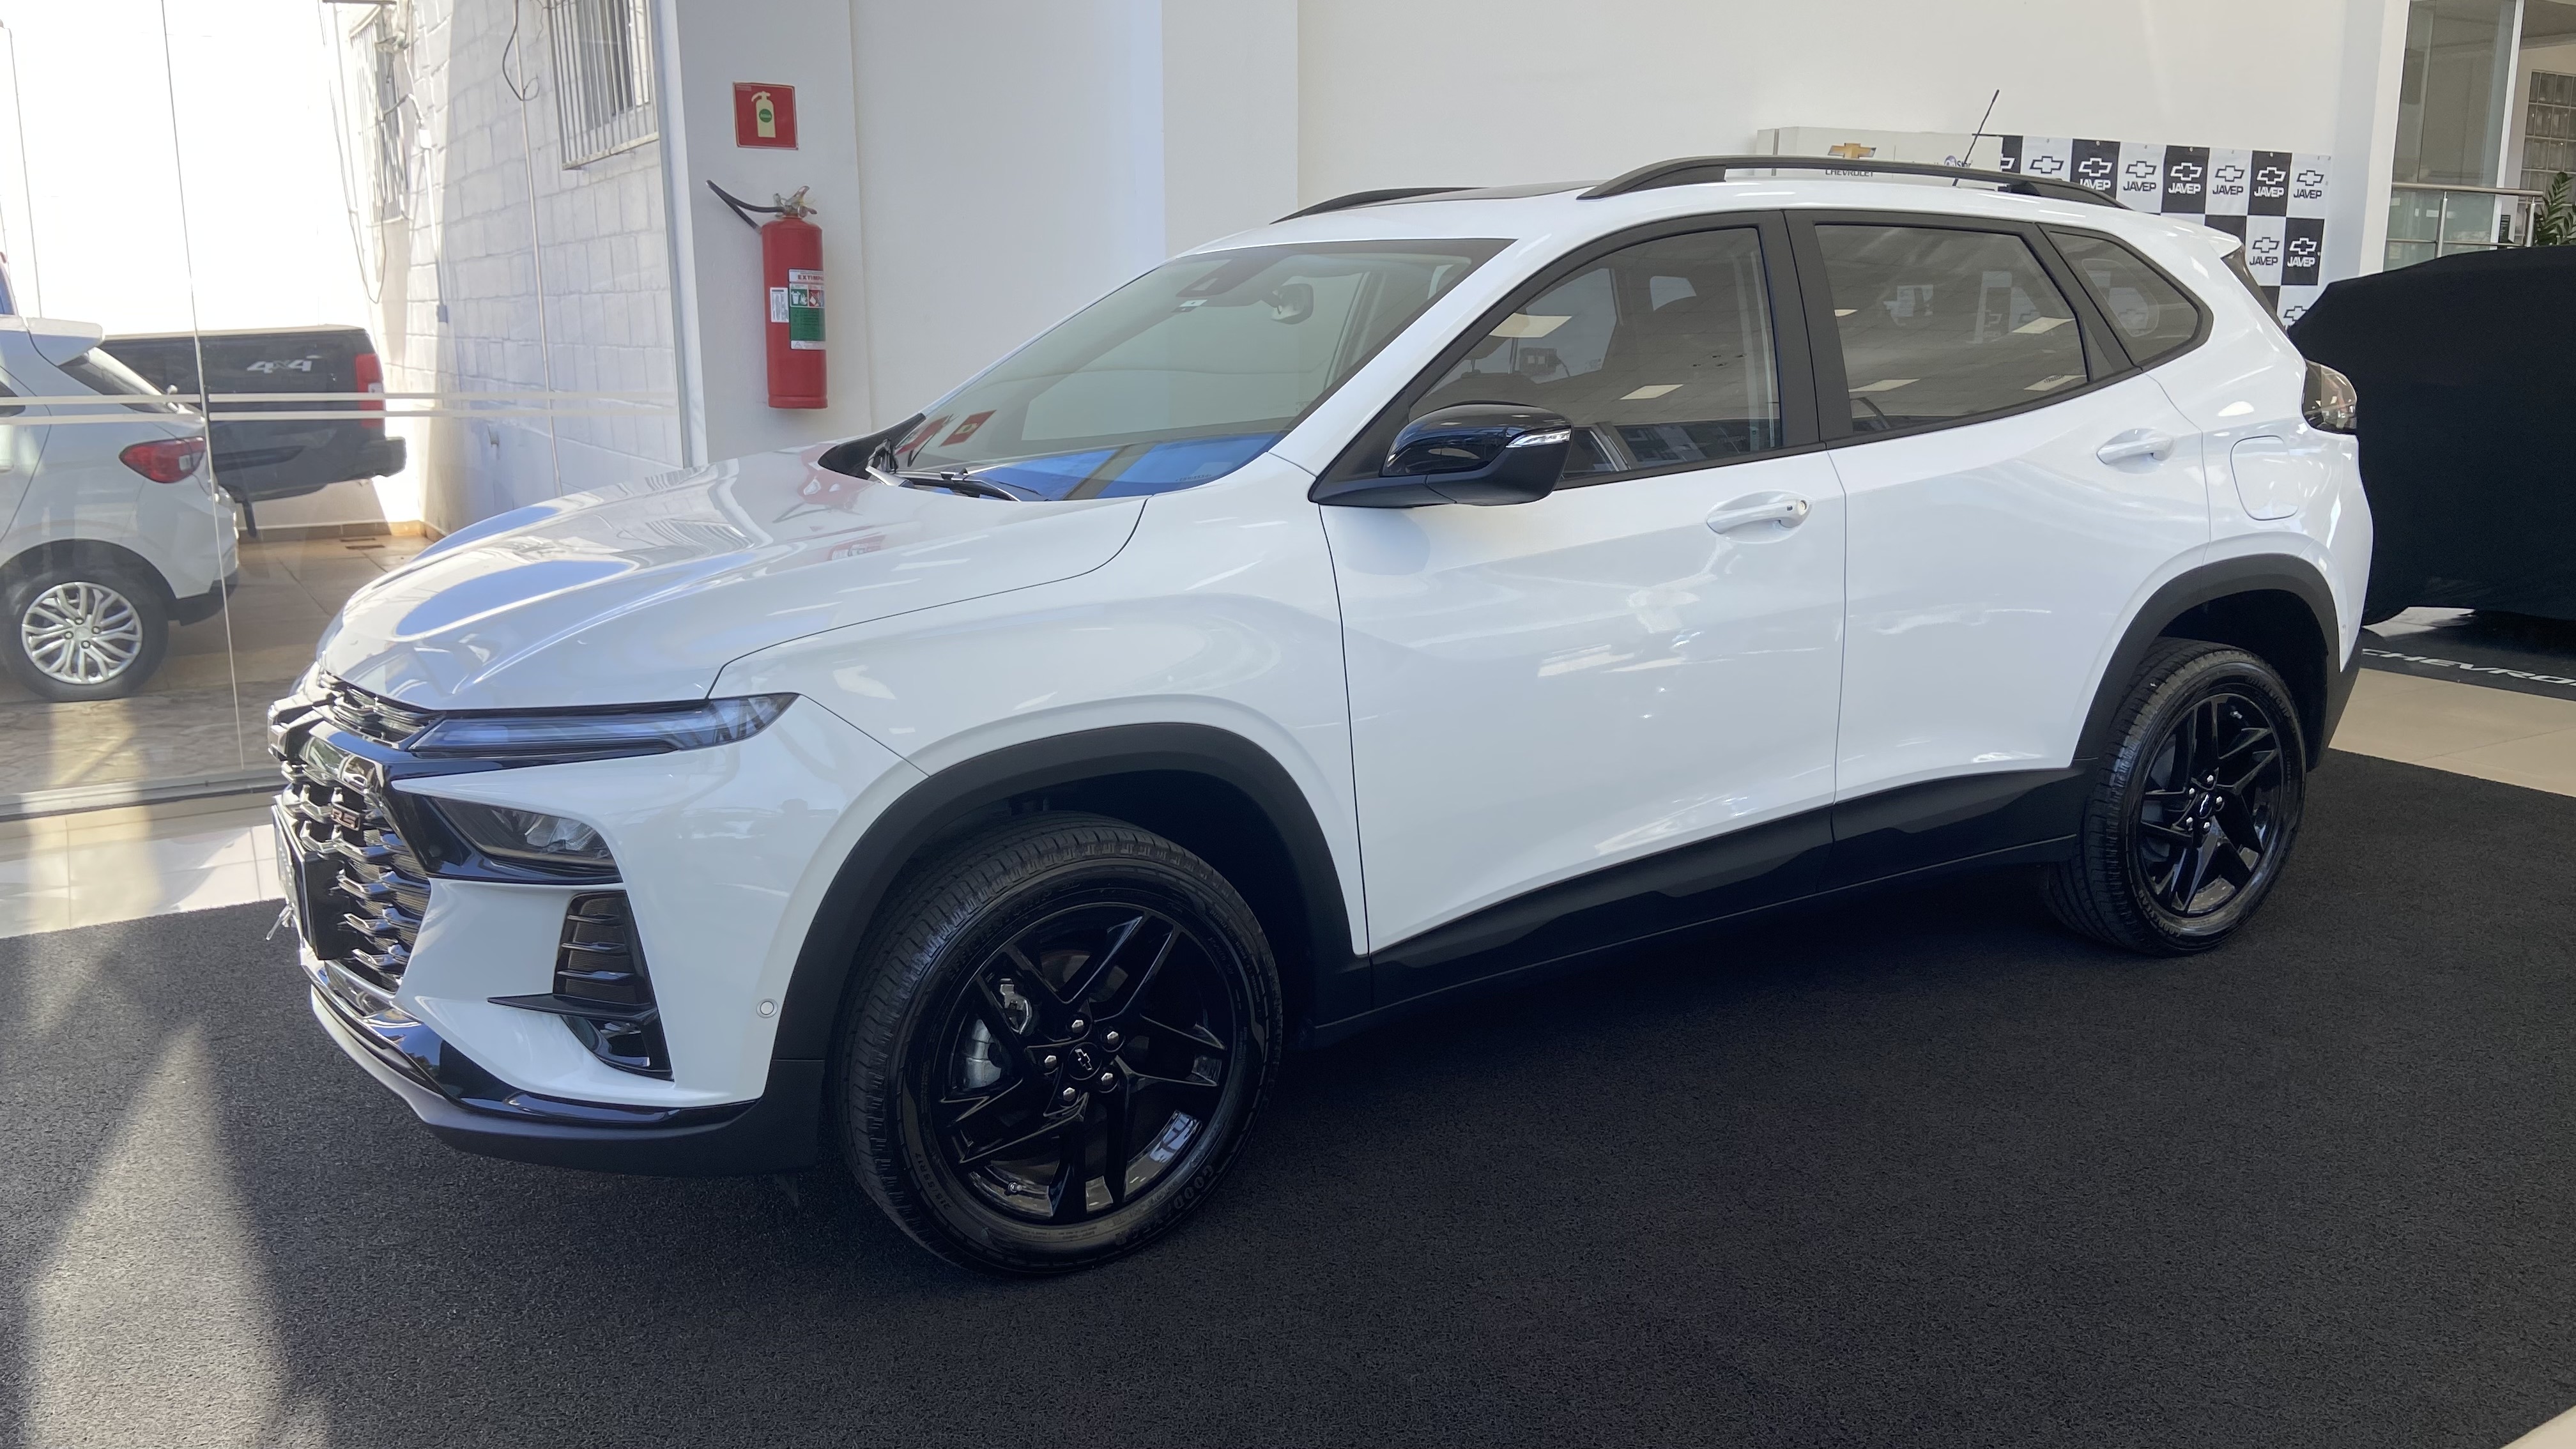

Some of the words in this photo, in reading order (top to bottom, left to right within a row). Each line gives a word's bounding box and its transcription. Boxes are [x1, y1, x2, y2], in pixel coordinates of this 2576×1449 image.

[2123, 181, 2156, 192] JAVEP
[2168, 183, 2201, 194] JAVEP
[2212, 185, 2243, 195] JAVEP
[2254, 186, 2285, 197] JAVEP
[2294, 189, 2322, 199] JAVEP
[2250, 256, 2278, 266] JAVEP
[2287, 256, 2316, 267] JAVEP
[2363, 648, 2576, 686] CHEVRO
[331, 808, 356, 829] RS
